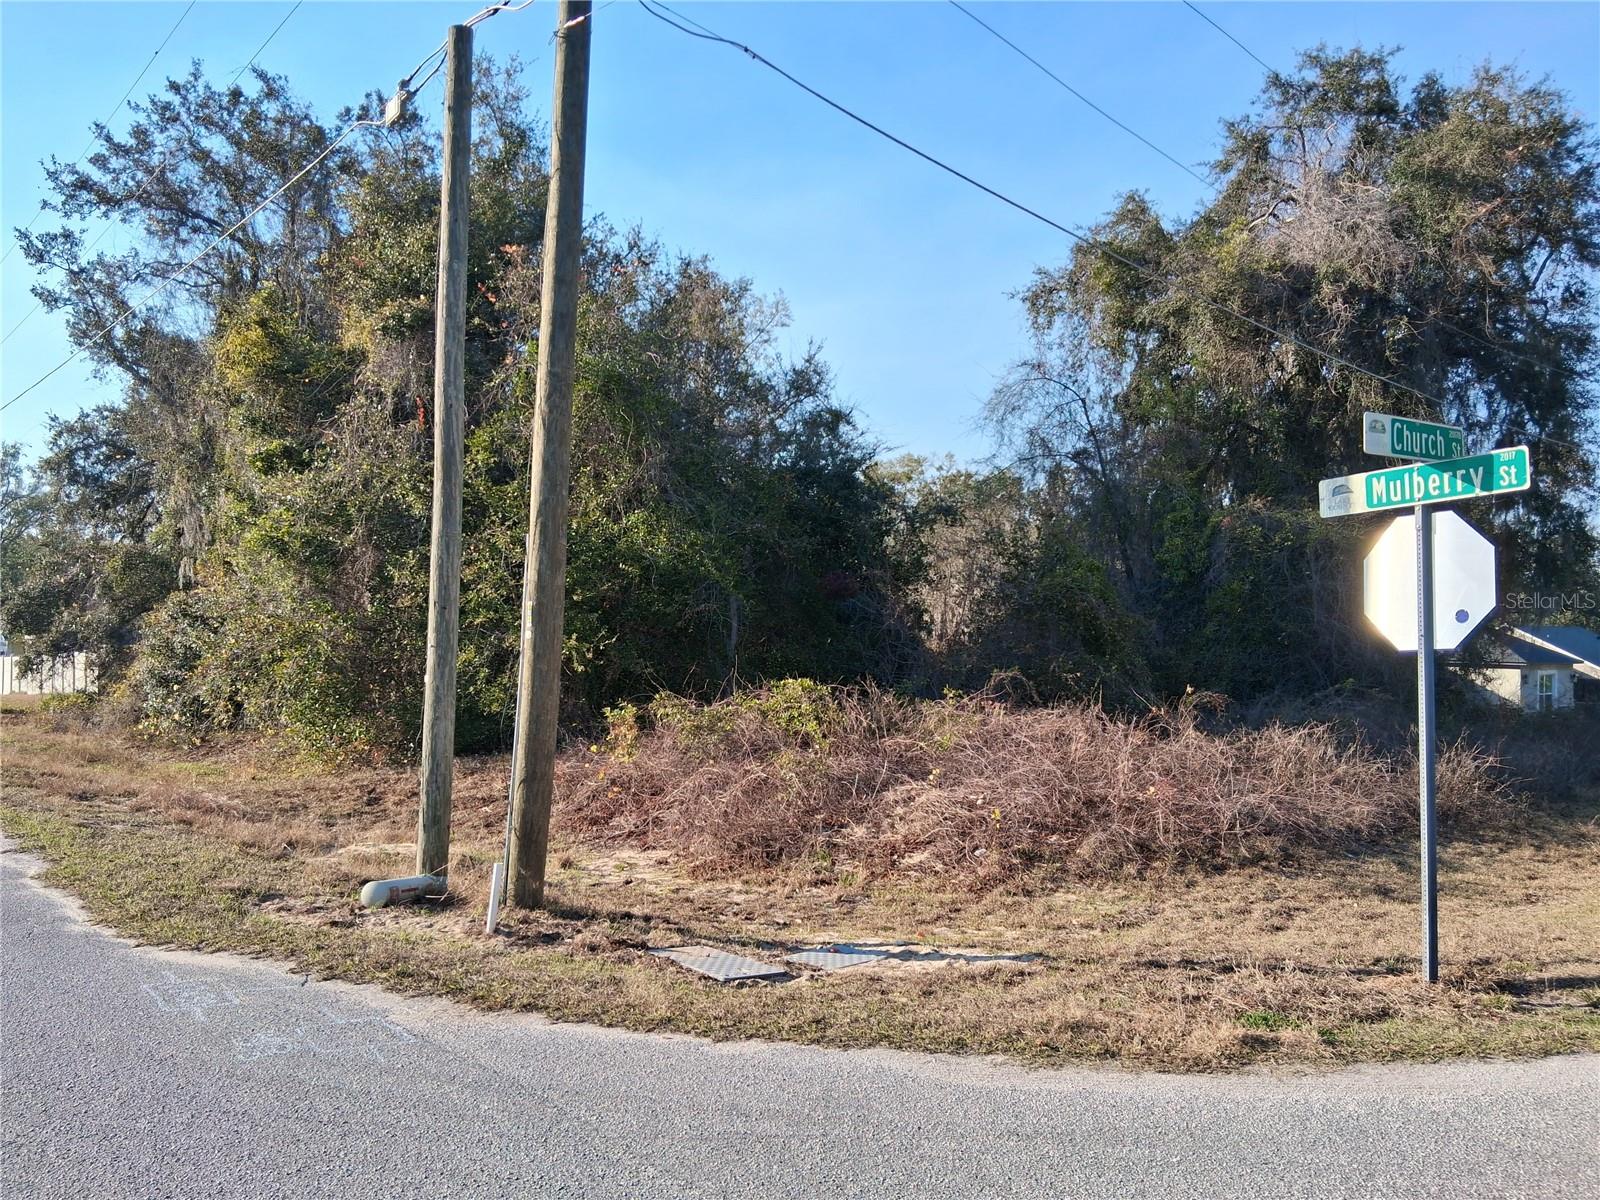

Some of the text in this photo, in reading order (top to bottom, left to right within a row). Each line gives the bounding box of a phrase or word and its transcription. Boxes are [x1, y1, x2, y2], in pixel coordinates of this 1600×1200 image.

[1393, 422, 1462, 458] Church St
[1499, 452, 1516, 462] 2017
[1372, 466, 1484, 504] Mulberry
[1499, 465, 1518, 486] St
